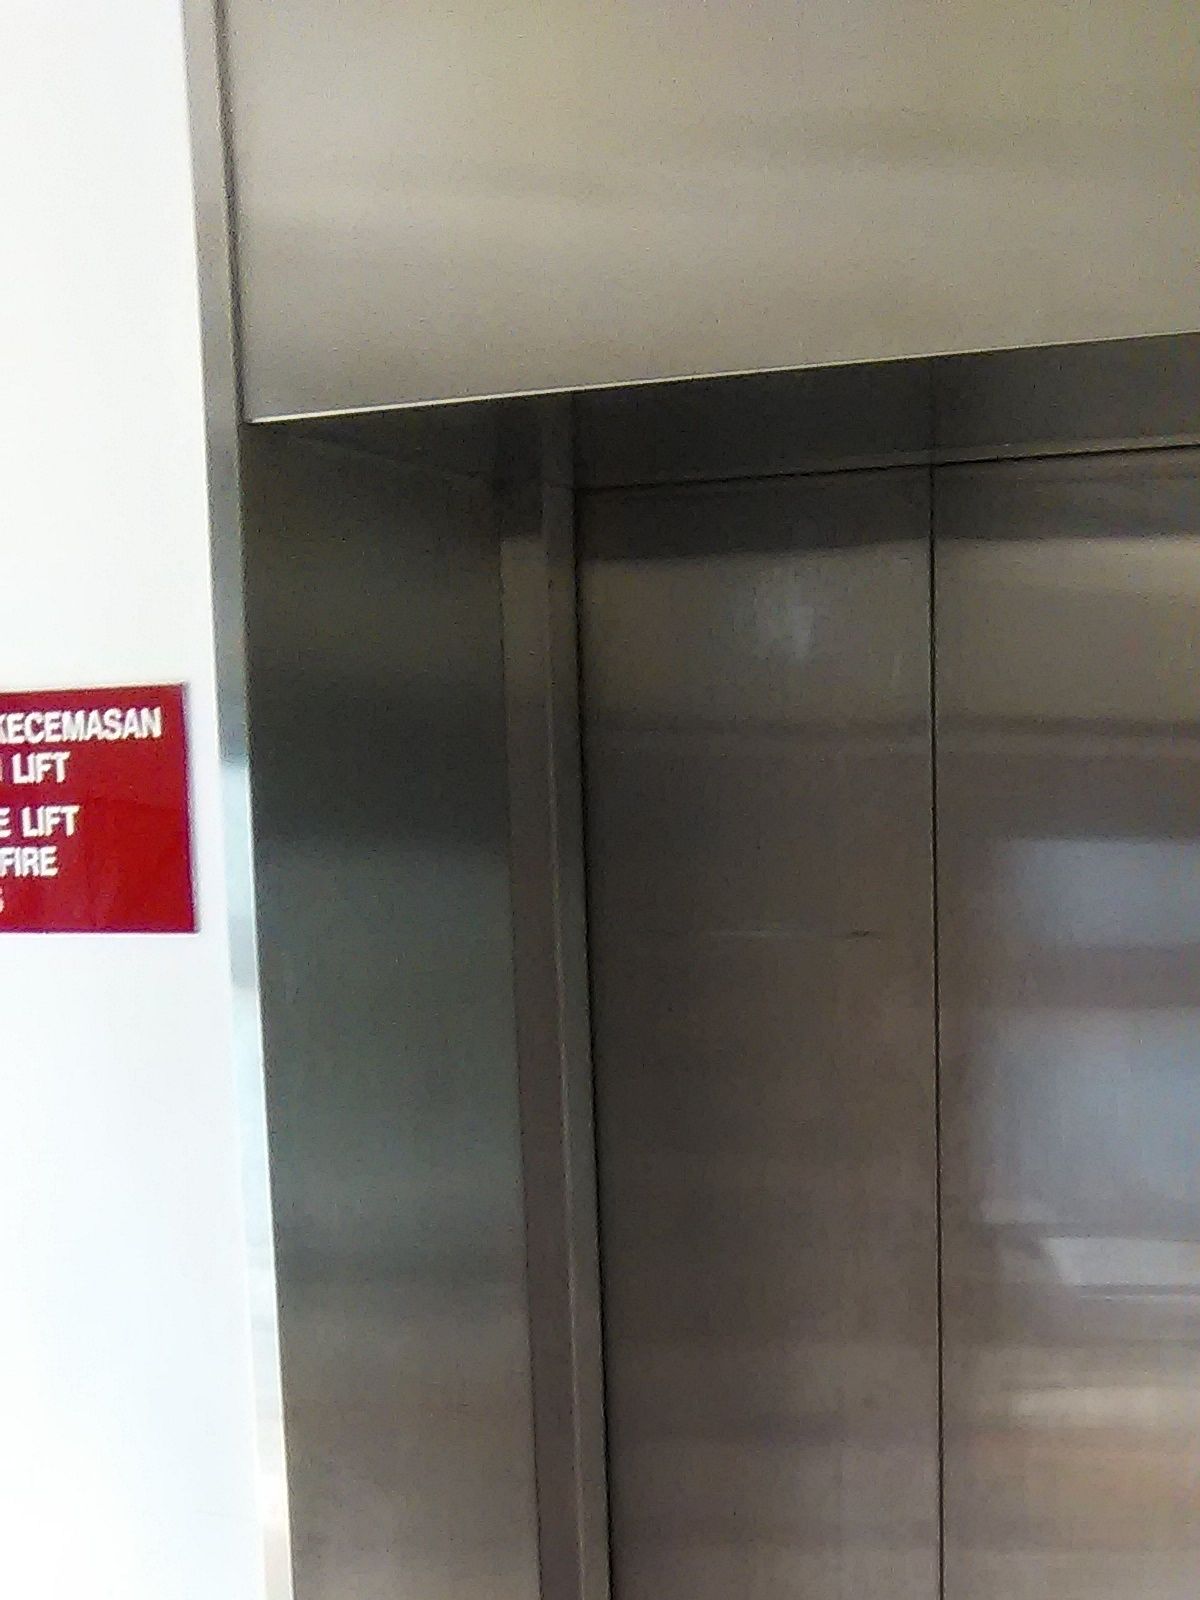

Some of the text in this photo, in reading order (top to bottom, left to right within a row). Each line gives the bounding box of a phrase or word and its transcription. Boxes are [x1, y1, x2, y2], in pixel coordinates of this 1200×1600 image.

[12, 752, 70, 783] LIFT
[22, 805, 80, 837] LIFT
[0, 846, 59, 877] FIRE
